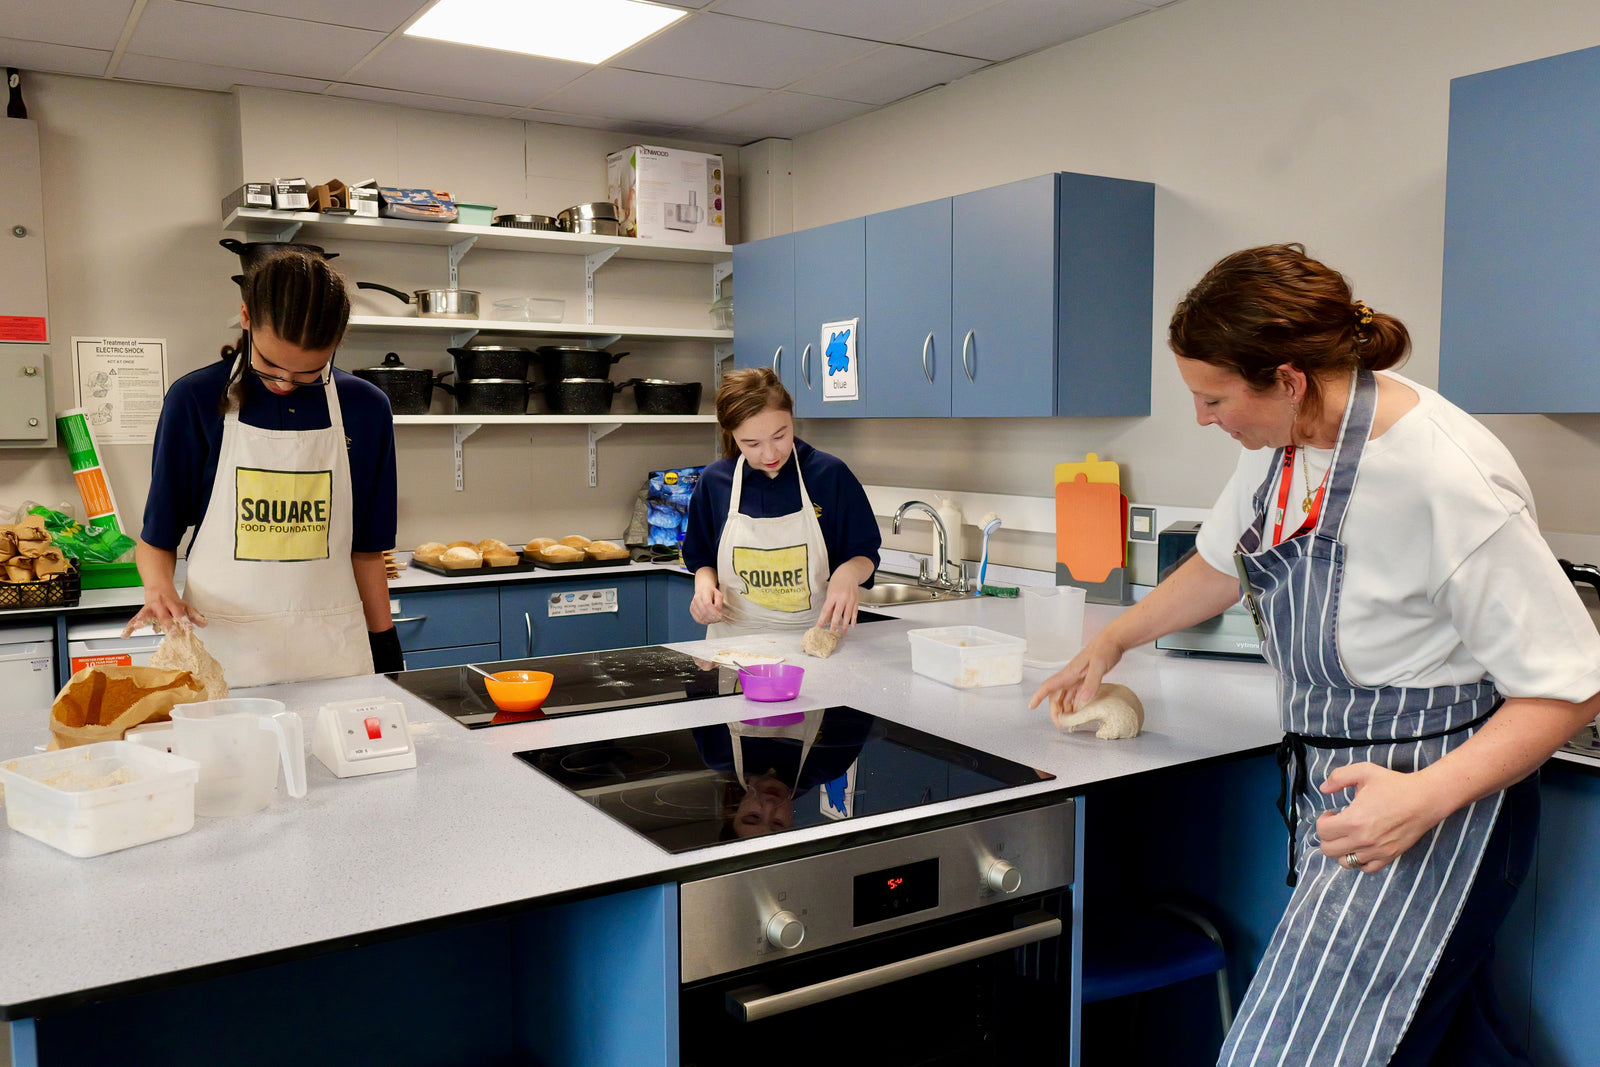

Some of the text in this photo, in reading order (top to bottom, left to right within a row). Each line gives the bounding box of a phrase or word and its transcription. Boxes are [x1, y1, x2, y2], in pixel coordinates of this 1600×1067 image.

[639, 148, 669, 157] KENWOOD
[833, 379, 847, 389] blue
[241, 497, 326, 523] SQUARE
[241, 523, 327, 533] FOOD FOUNDATION
[739, 568, 804, 588] SQUARE
